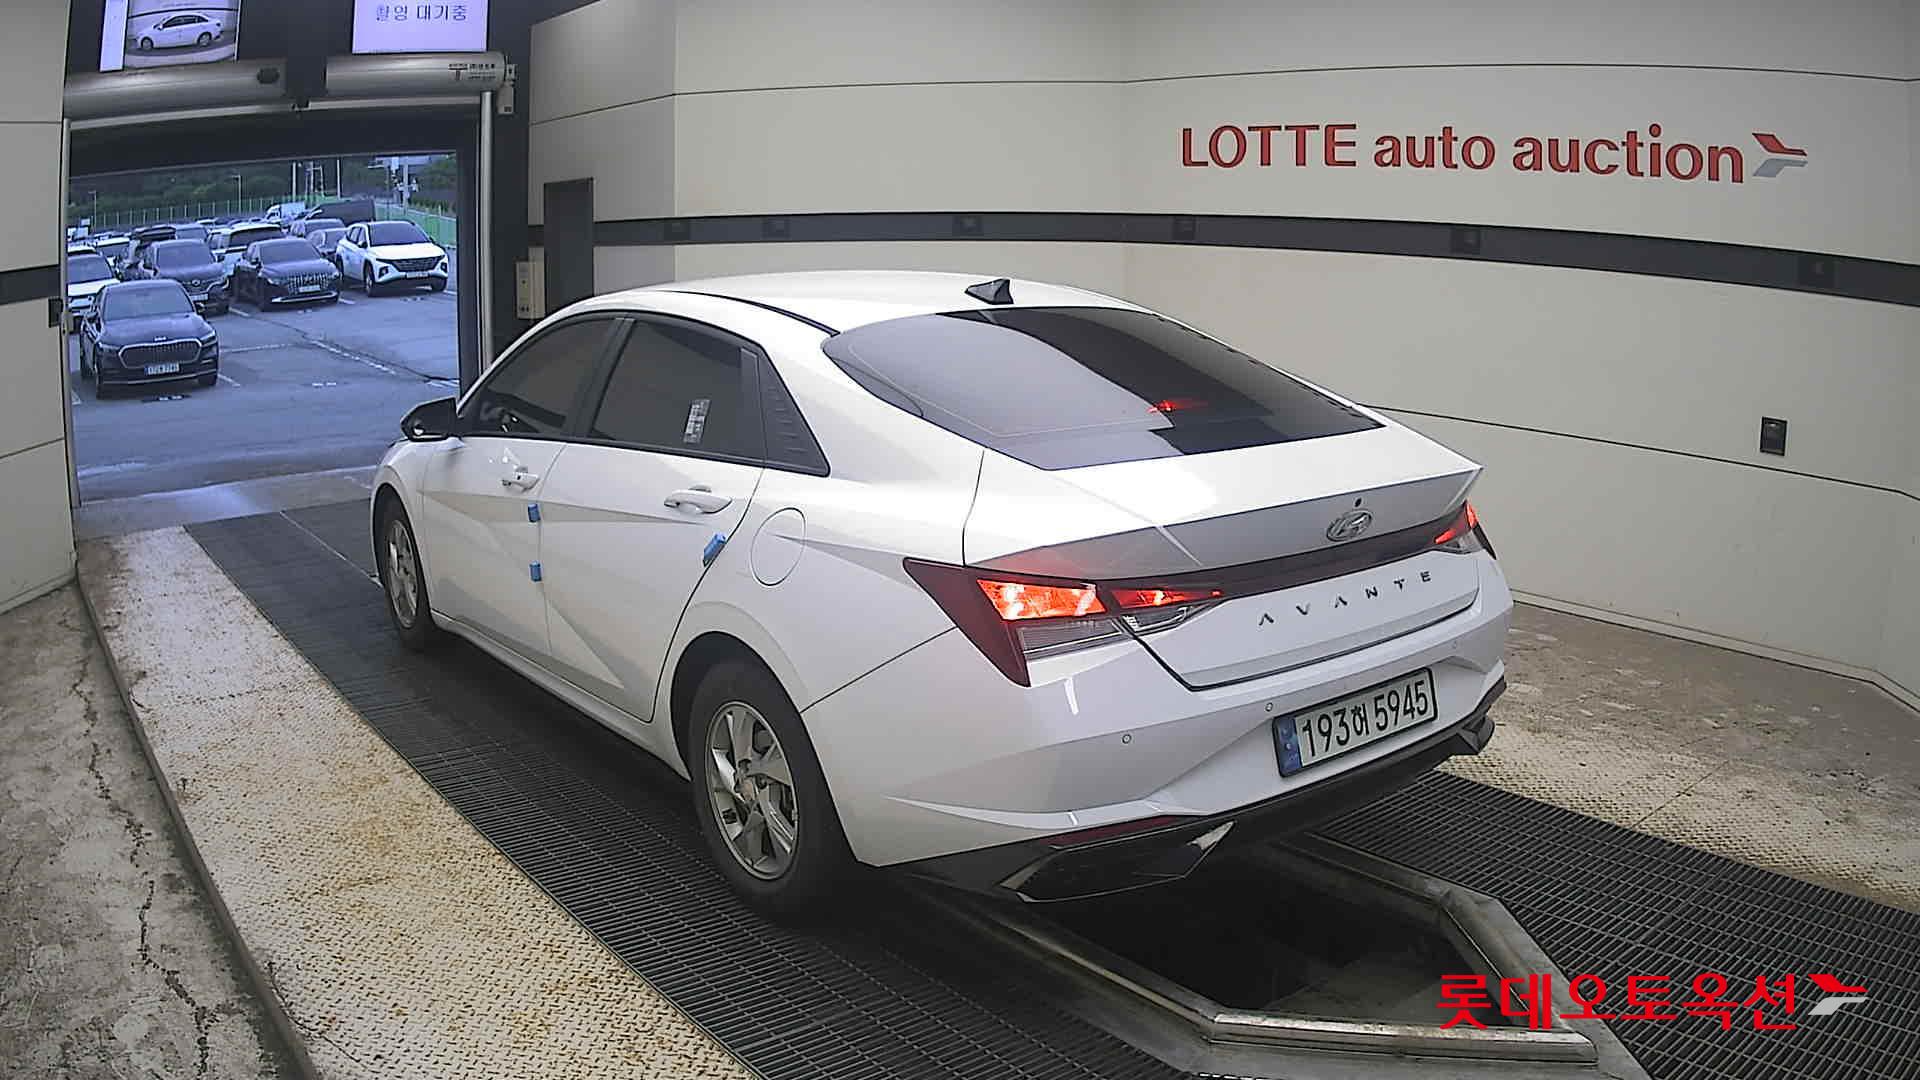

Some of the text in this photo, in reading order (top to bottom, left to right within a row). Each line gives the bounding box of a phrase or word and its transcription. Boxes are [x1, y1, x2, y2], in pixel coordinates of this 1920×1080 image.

[416, 4, 467, 22] 대기중
[1182, 123, 1744, 185] LOTTE auto auction
[1258, 570, 1432, 627] AVANTE
[1374, 679, 1428, 731] 5945
